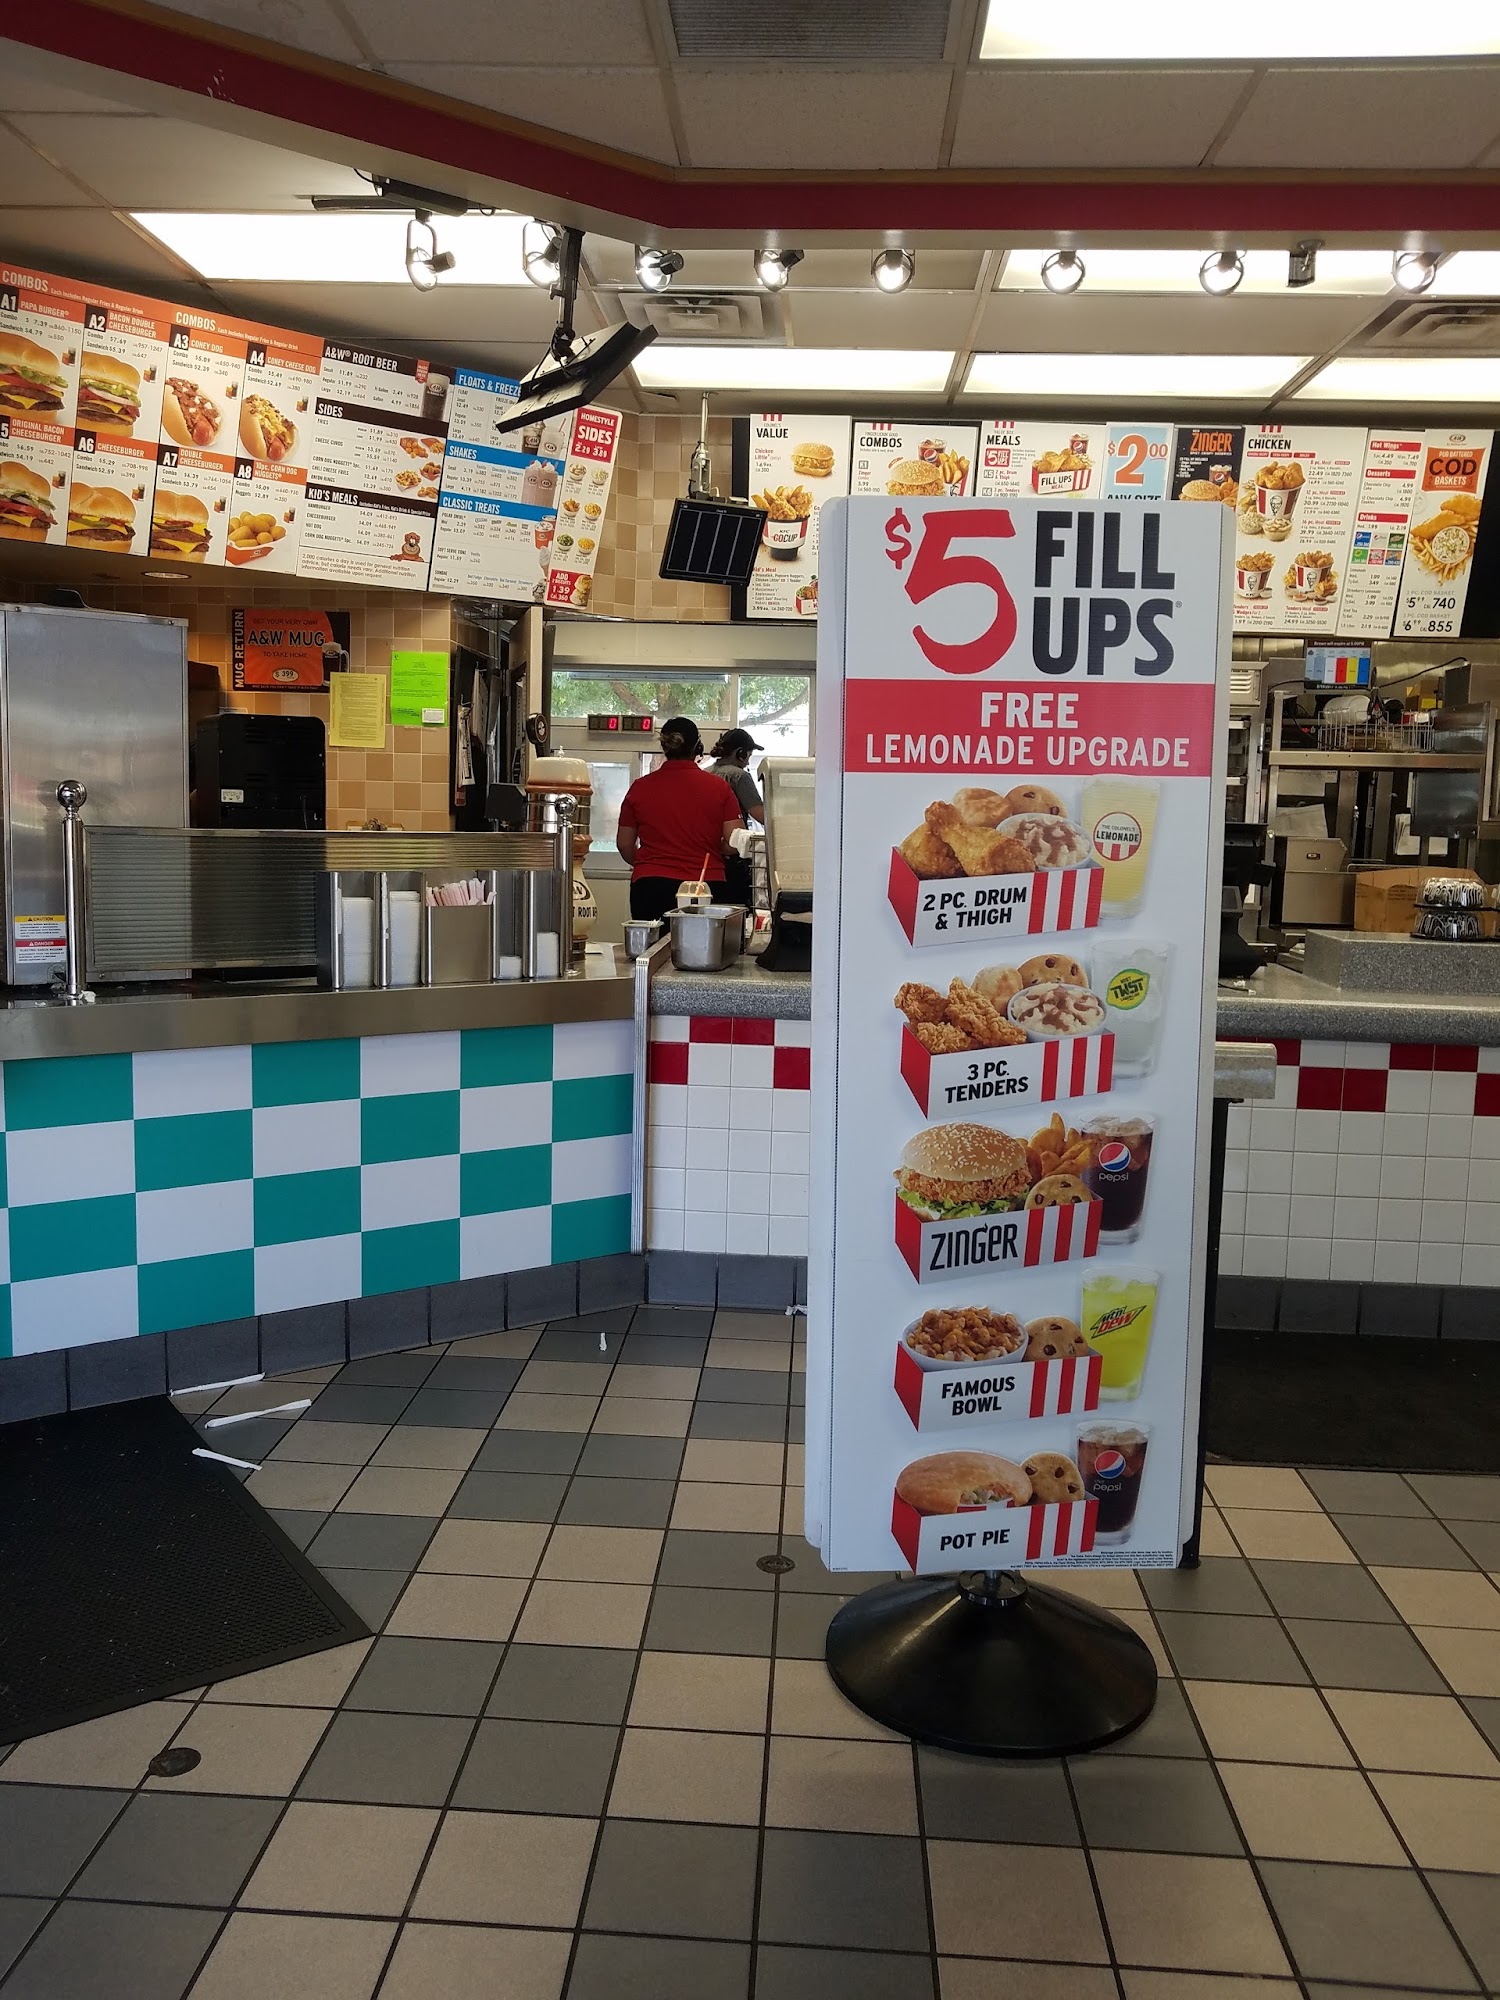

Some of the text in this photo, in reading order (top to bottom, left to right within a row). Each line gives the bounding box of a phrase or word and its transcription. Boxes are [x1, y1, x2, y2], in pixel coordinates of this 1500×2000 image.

[2, 270, 48, 292] COMBOS
[1, 294, 17, 310] A1
[21, 301, 37, 311] PAPA
[1, 312, 18, 321] Combo
[89, 314, 106, 330] A2
[110, 313, 155, 329] BACON DOUBLE
[176, 312, 216, 330] COMBOS
[0, 322, 23, 333] Sandwich
[109, 321, 156, 338] CHEESEBURGER
[88, 332, 103, 340] Combo
[174, 334, 189, 349] A3
[87, 341, 108, 351] Sandwich
[191, 340, 223, 353] CONEY DOG
[173, 351, 188, 359] Combo
[250, 350, 264, 365] A4
[352, 352, 375, 367] ROOT
[376, 357, 398, 371] BEER
[172, 360, 193, 369] Sandwich
[249, 366, 263, 374] Combo
[267, 357, 316, 373] CONEY CHEESE DOG
[248, 376, 267, 385] Sandwich
[459, 375, 521, 397] FLOATS & FREEZE
[318, 404, 343, 417] SIDES
[12, 419, 65, 434] ORIGINAL BACON
[581, 413, 614, 426] HOMESTYLE
[0, 423, 9, 438] 5
[12, 428, 62, 443] CHEESEBURGER
[578, 426, 612, 444] SIDES
[756, 428, 788, 438] VALUE
[78, 436, 94, 453] A6
[860, 437, 902, 448] COMBOS
[986, 435, 1020, 446] MEALS
[1190, 432, 1232, 452] ZINGER
[1248, 439, 1291, 450] CHICKEN
[98, 443, 144, 457] CHEESEBURGER
[180, 449, 203, 460] DOUBLE
[449, 446, 477, 459] SHAKES
[77, 454, 92, 462] Combo
[163, 452, 178, 466] A7
[180, 458, 223, 471] CHEESEBURGER
[76, 464, 98, 473] Sandwich
[238, 464, 252, 478] A8
[271, 465, 286, 474] CORN
[1429, 458, 1477, 475] COD
[162, 478, 182, 486] Sandwich
[236, 480, 250, 488] Combo
[1042, 475, 1072, 486] FILL UPS
[1435, 476, 1467, 486] BASKETS
[308, 488, 358, 505] KID'S MEALS
[443, 497, 500, 514] CLASSIC TREATS
[1034, 510, 1175, 590] FILL
[885, 507, 1017, 675] $5
[1433, 598, 1455, 609] 740
[1428, 621, 1453, 632] 855
[248, 630, 325, 647] A&W MUG
[235, 611, 244, 688] MUG RETURN
[980, 692, 1079, 729] FREE
[866, 734, 1190, 767] LEMONADE UPGRADE
[1096, 831, 1139, 842] LEMONADE
[922, 886, 1027, 912] 2 PC. DRUM
[935, 907, 1013, 930] & THIGH
[967, 1060, 1010, 1081] 3 PC.
[944, 1076, 1029, 1104] TENDERS
[1099, 1172, 1129, 1182] pepsi
[930, 1222, 1018, 1271] ZINGER
[941, 1376, 1015, 1399] FAMOUS
[952, 1396, 1002, 1416] BOWL
[1094, 1483, 1121, 1492] pepsi
[940, 1529, 1010, 1551] POT PIE
